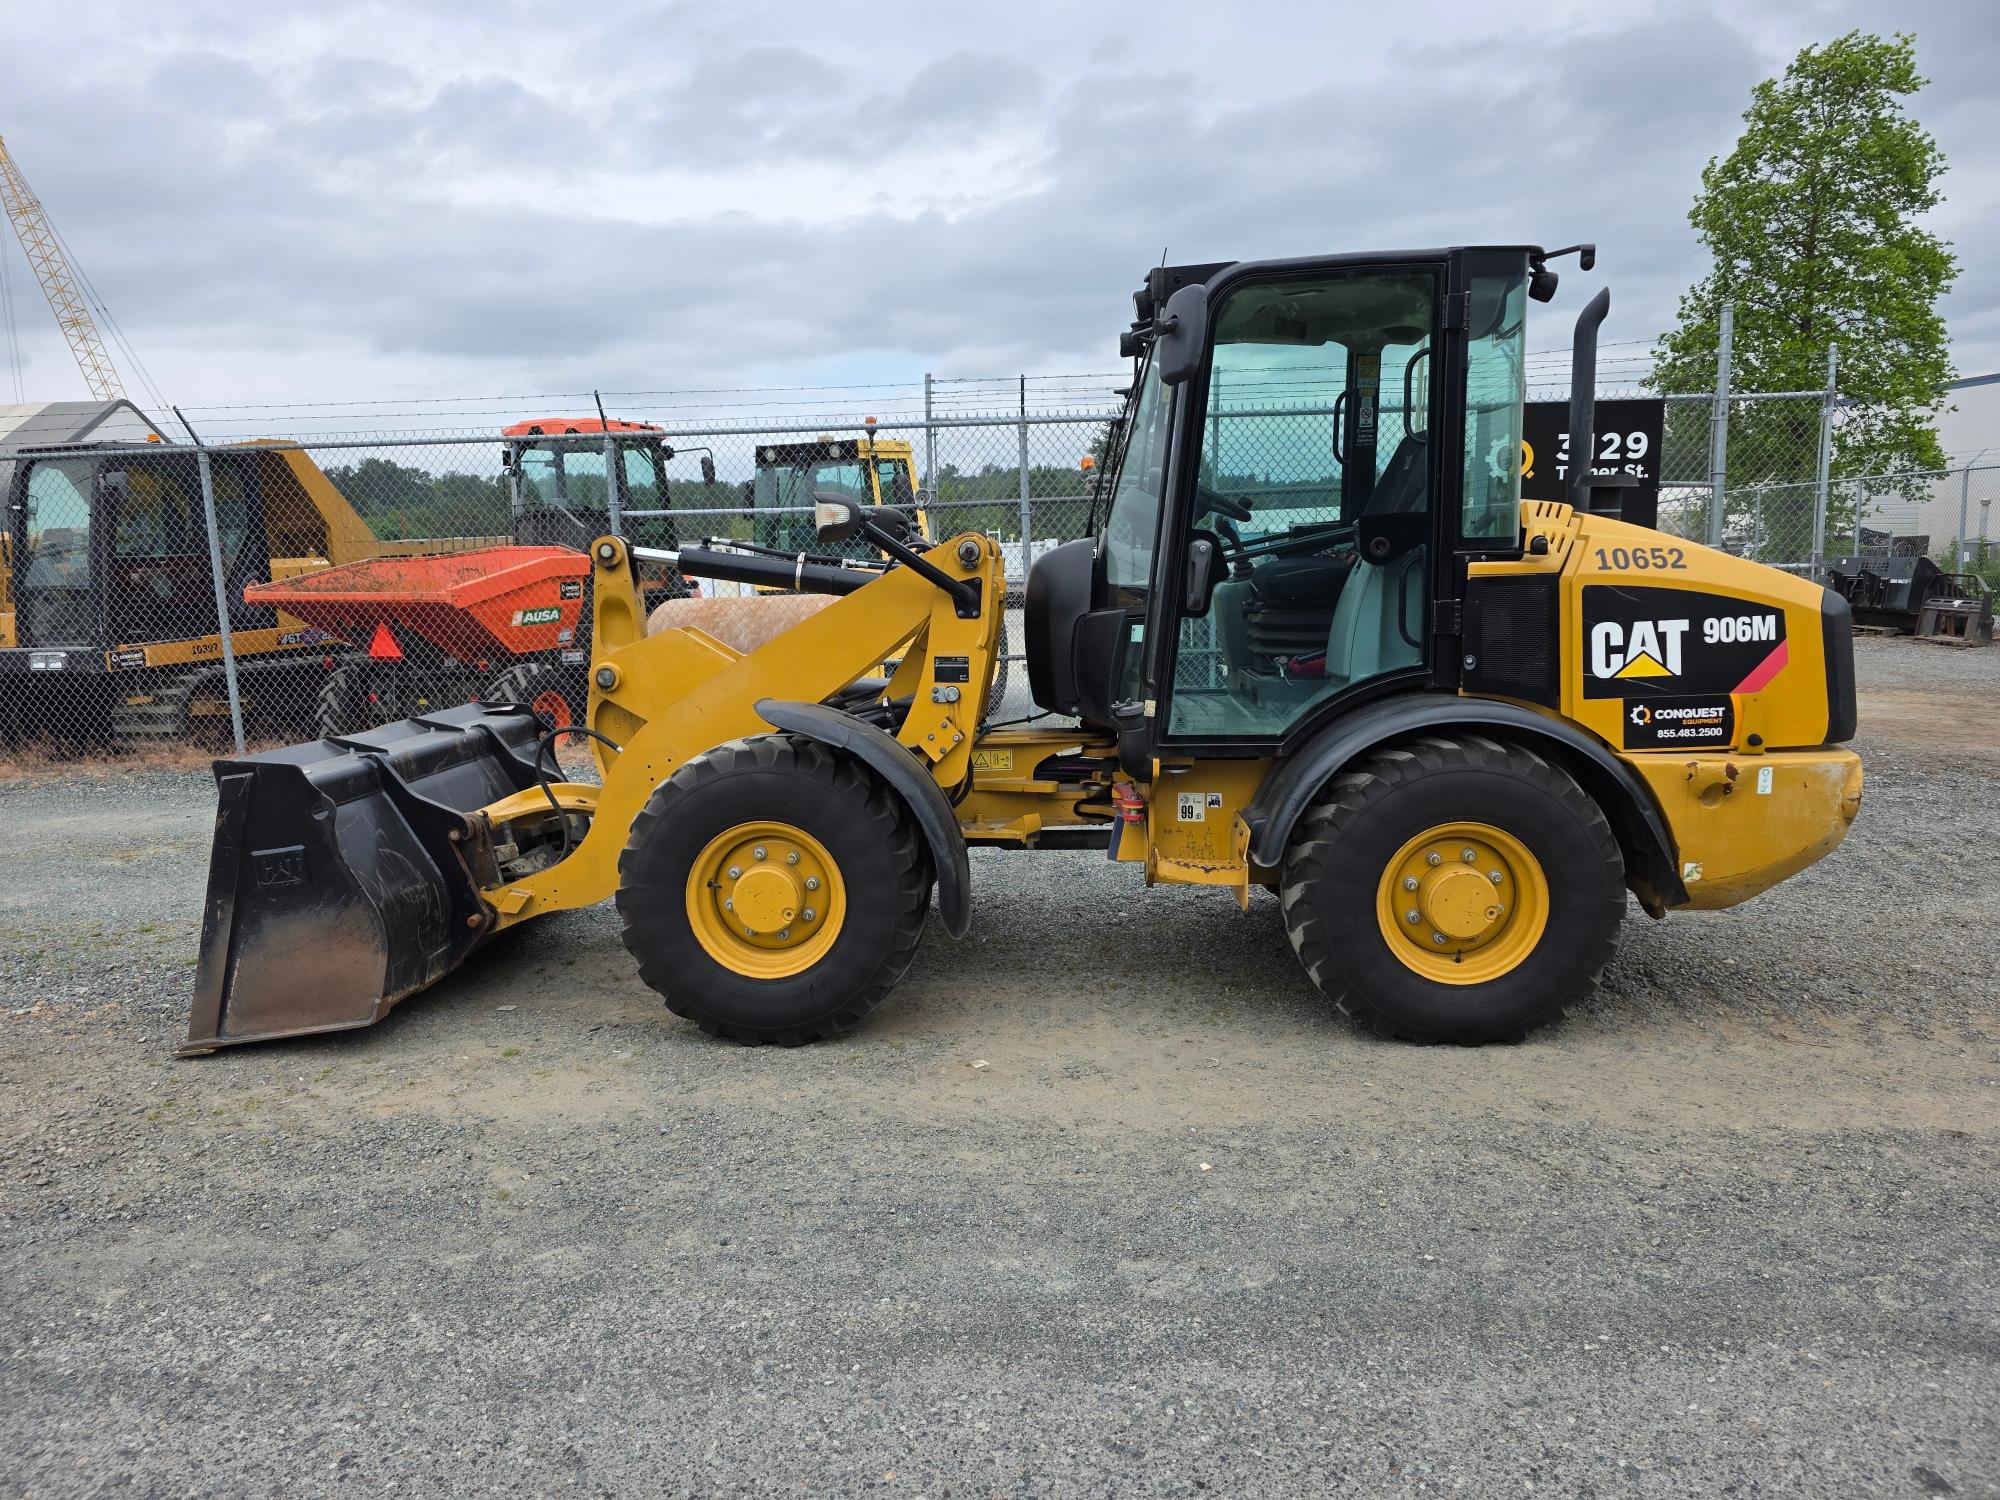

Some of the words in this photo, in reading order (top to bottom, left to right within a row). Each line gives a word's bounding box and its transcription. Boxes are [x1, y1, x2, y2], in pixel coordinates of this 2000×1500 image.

[1556, 431, 1649, 461] 329
[1595, 547, 1687, 570] 10652
[523, 609, 559, 623] AUSA
[1703, 614, 1776, 644] 906M
[1591, 619, 1690, 679] CAT
[1654, 707, 1725, 719] CONQUEST
[1657, 727, 1723, 738] 855.483.2500
[1181, 805, 1194, 819] 99
